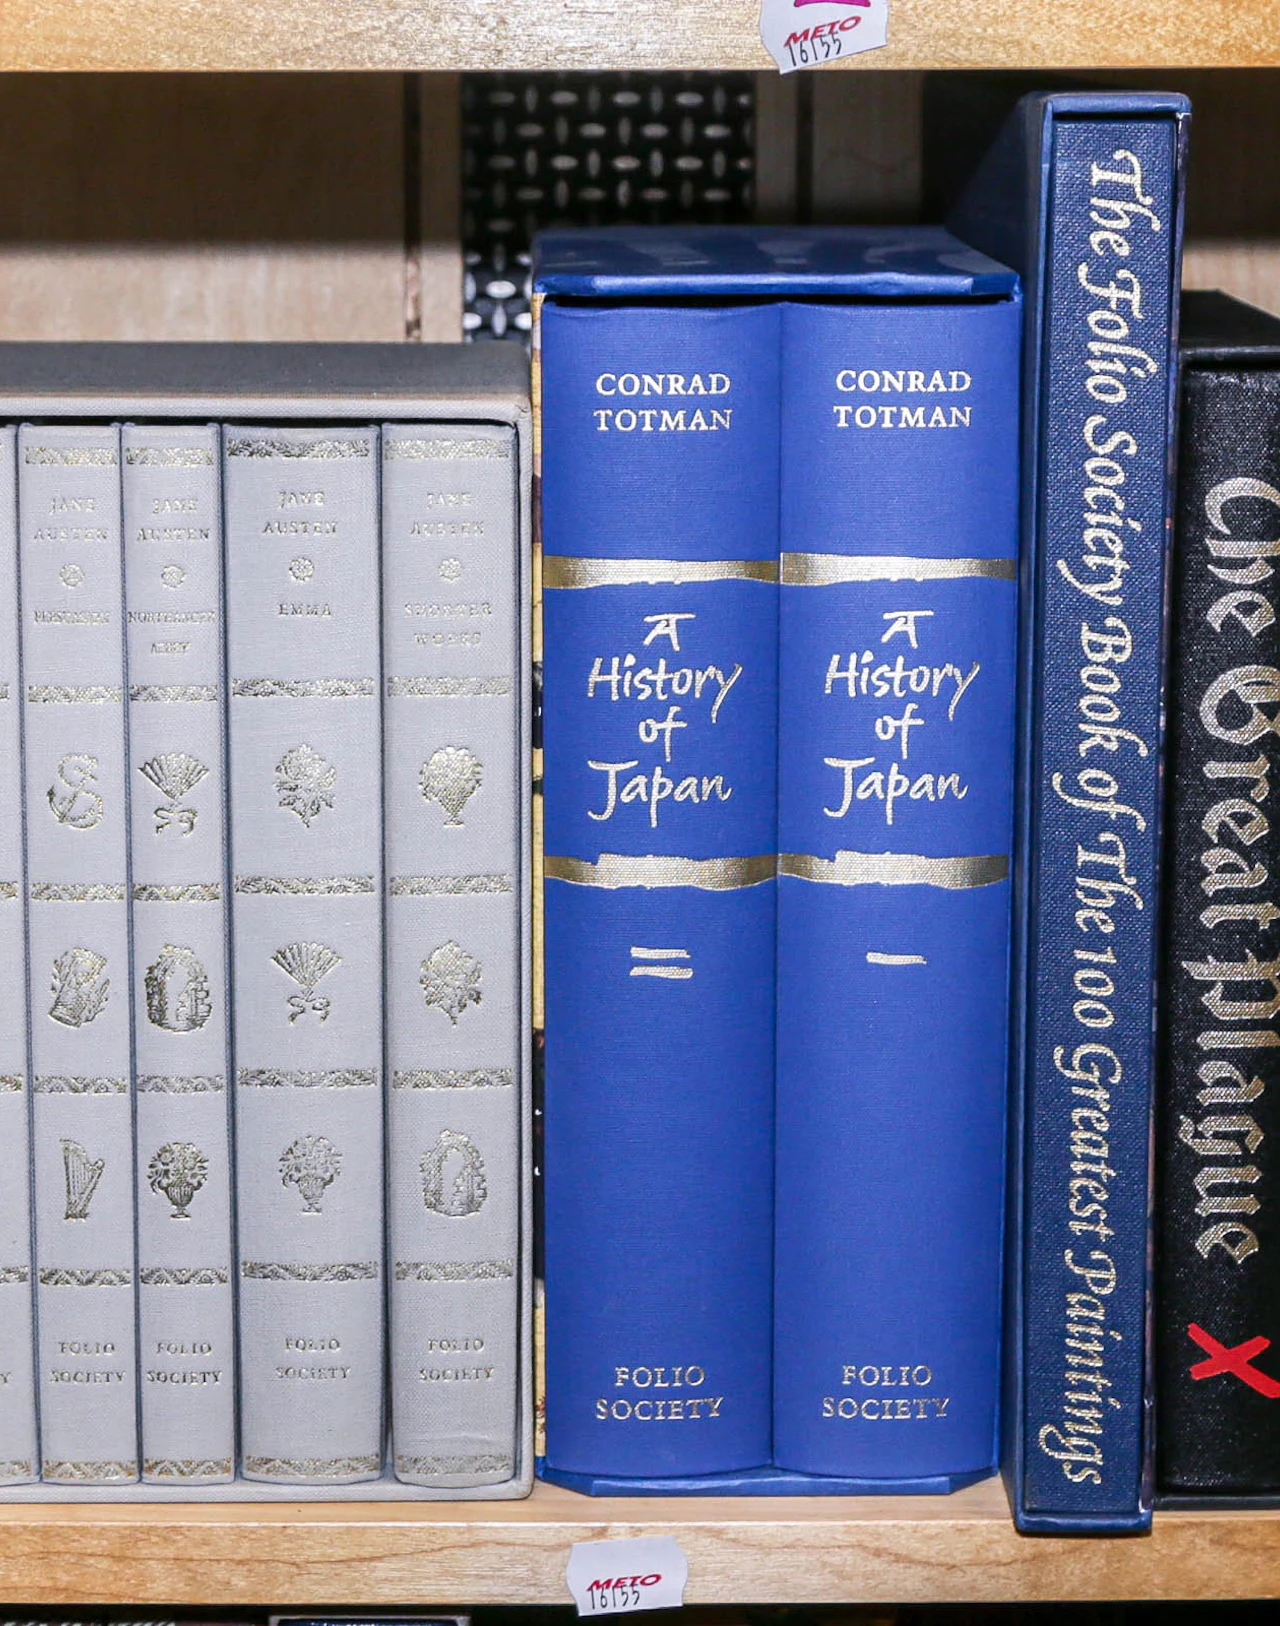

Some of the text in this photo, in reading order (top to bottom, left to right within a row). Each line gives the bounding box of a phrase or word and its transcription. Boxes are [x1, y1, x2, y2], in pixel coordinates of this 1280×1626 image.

[784, 16, 861, 47] METO
[595, 373, 731, 396] CONRAD
[836, 369, 972, 393] CONRAD
[593, 409, 733, 431] TOTMAN
[833, 405, 973, 428] TOTMAN
[137, 528, 210, 542] AUSTEN
[261, 521, 338, 536] AUSTEN
[278, 603, 332, 618] EMMA
[642, 613, 696, 651] A
[881, 609, 934, 649] A
[587, 652, 743, 723] History
[825, 650, 980, 721] History
[638, 705, 687, 762] of
[875, 702, 925, 760] of
[587, 759, 733, 828] Japan
[823, 756, 969, 826] Japan
[1038, 149, 1161, 1485] The Folio Society Book of The 100 Greatest Paintings
[58, 1341, 116, 1356] FOLIO
[156, 1341, 212, 1356] FOLIO
[284, 1337, 341, 1352] FOLIO
[428, 1337, 485, 1353] FOLIO
[49, 1370, 126, 1385] SOCIETY
[146, 1369, 222, 1385] SOCIETY
[275, 1366, 351, 1381] SOCIETY
[419, 1366, 495, 1382] SOCIETY
[614, 1365, 705, 1388] FOLIO
[842, 1365, 933, 1387] FOLIO
[595, 1396, 724, 1421] SOCIETY
[822, 1396, 950, 1420] SOCIETY
[587, 1574, 662, 1591] METO
[591, 1585, 640, 1610] 16155
